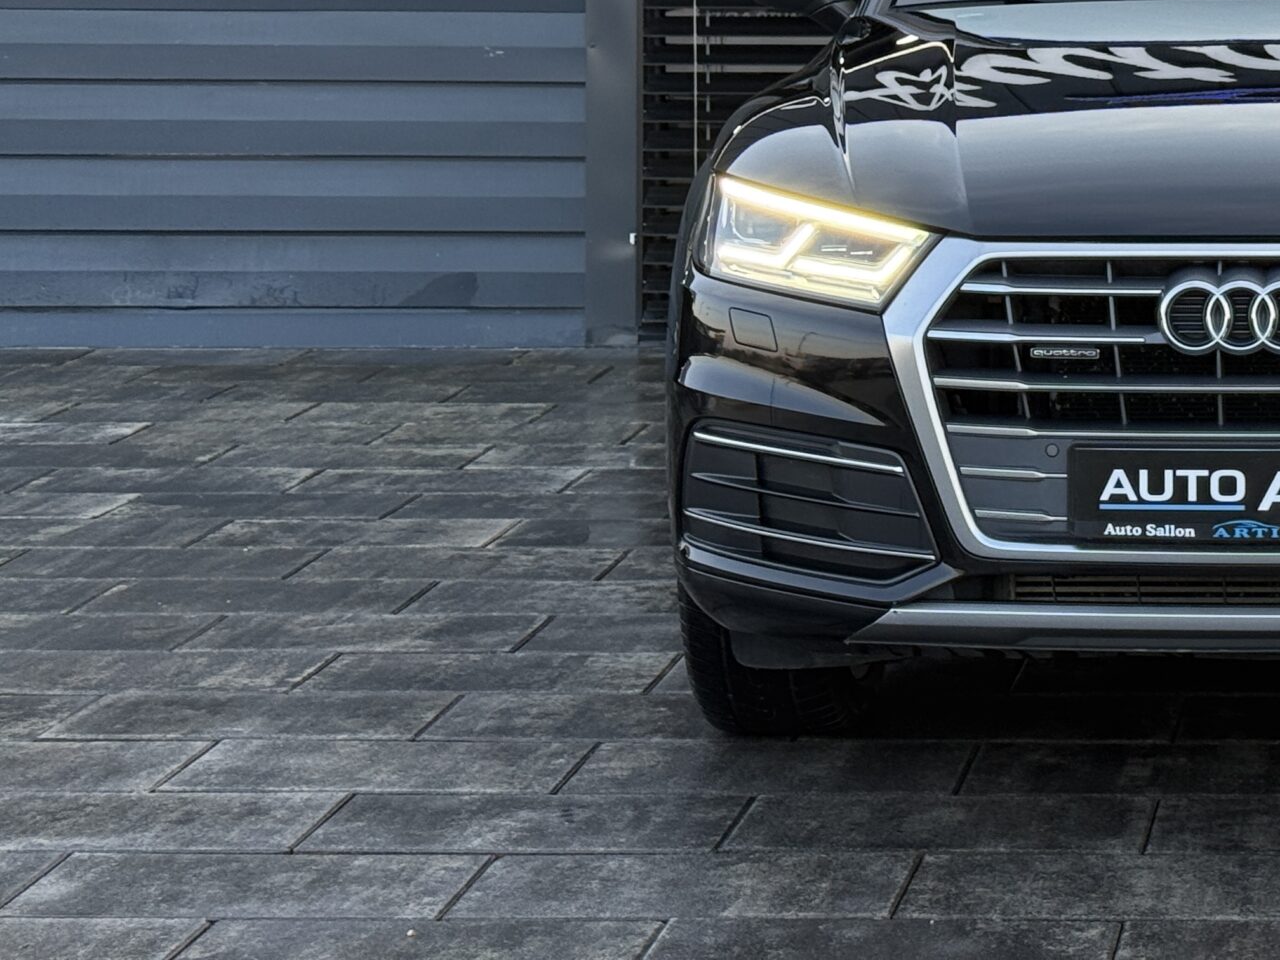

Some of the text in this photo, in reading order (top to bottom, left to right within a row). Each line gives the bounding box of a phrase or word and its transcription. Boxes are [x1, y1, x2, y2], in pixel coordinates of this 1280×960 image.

[1033, 349, 1097, 357] quattro
[1100, 469, 1246, 502] AUTO
[1103, 523, 1142, 537] Auto
[1145, 523, 1196, 538] Sallon
[1212, 527, 1280, 539] ARTI
